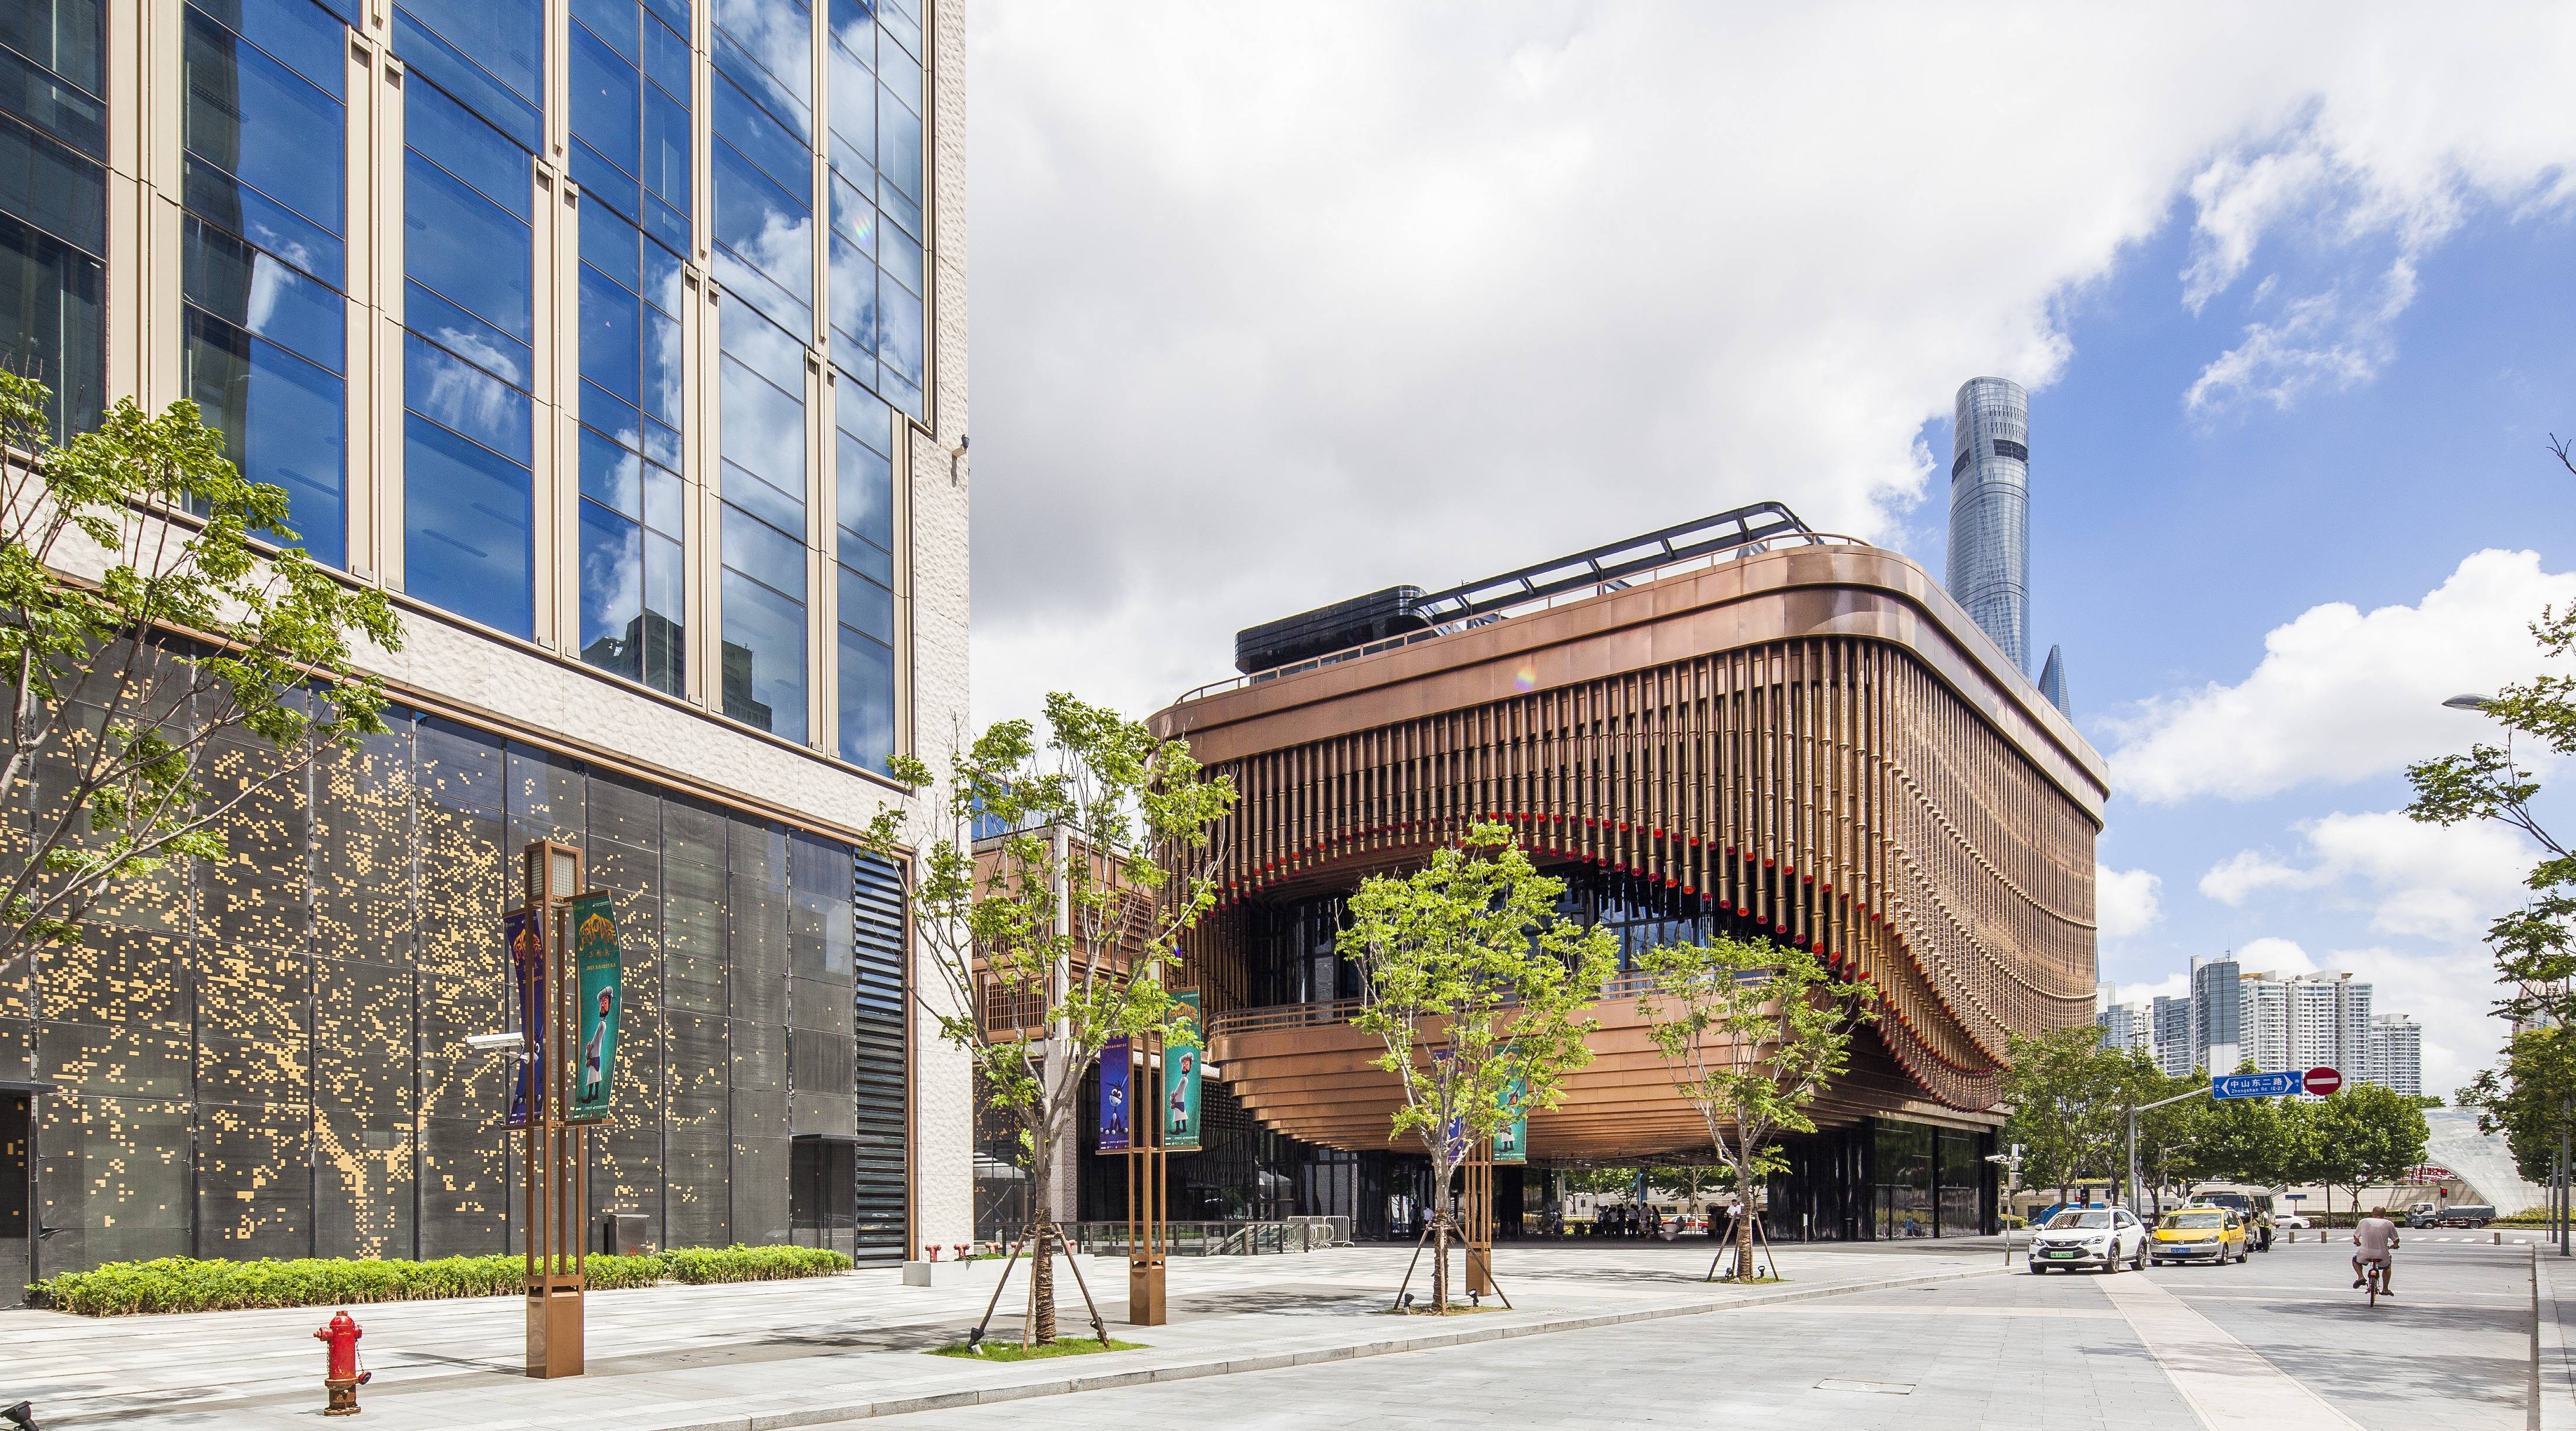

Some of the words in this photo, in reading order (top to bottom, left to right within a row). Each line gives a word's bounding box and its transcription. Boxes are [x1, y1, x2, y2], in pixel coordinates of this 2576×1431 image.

[2231, 1078, 2283, 1088] 中山东二路
